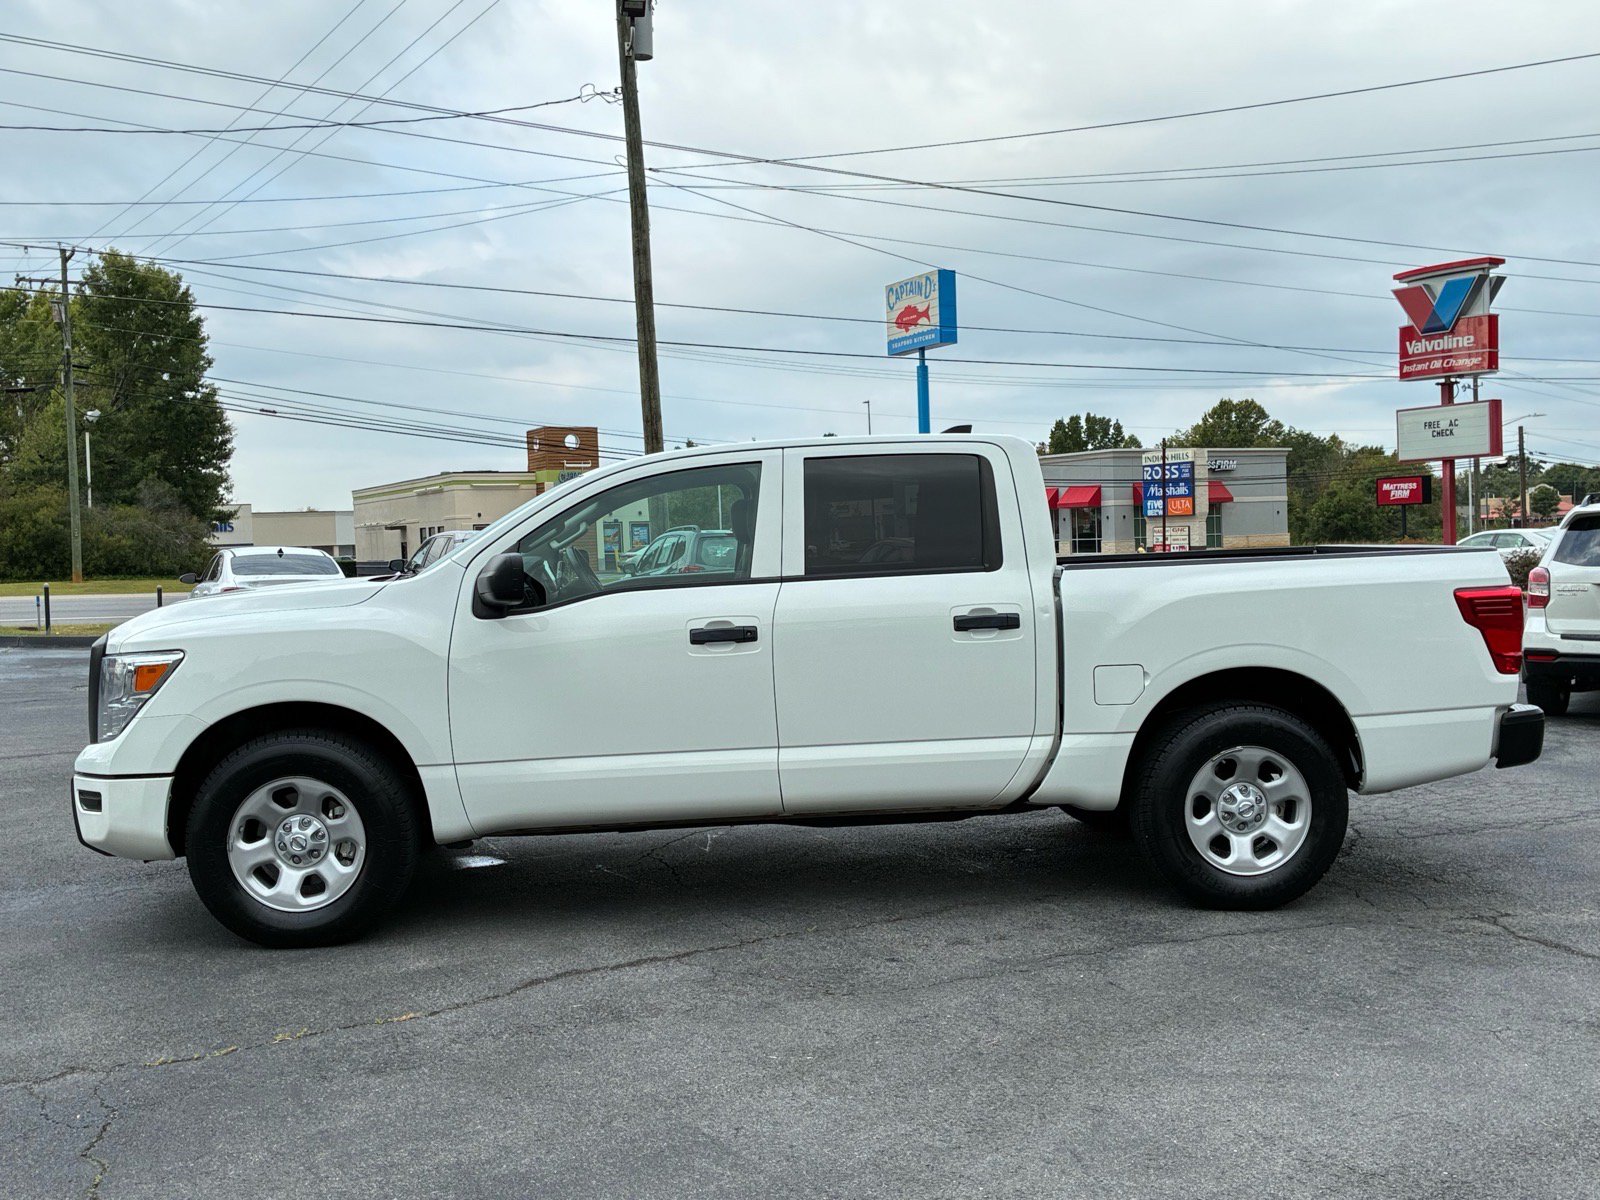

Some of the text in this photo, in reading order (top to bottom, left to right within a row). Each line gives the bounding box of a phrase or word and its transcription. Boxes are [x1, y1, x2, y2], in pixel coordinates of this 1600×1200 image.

[887, 281, 923, 310] CAPTAIN
[1405, 334, 1475, 355] Valvoline
[1402, 357, 1482, 374] Instant Oil Change
[1423, 418, 1459, 430] FREE AC
[1431, 428, 1455, 438] CHECK
[1170, 452, 1189, 461] HILLS
[1382, 482, 1417, 491] MATTRESS
[1390, 489, 1410, 499] FIRM
